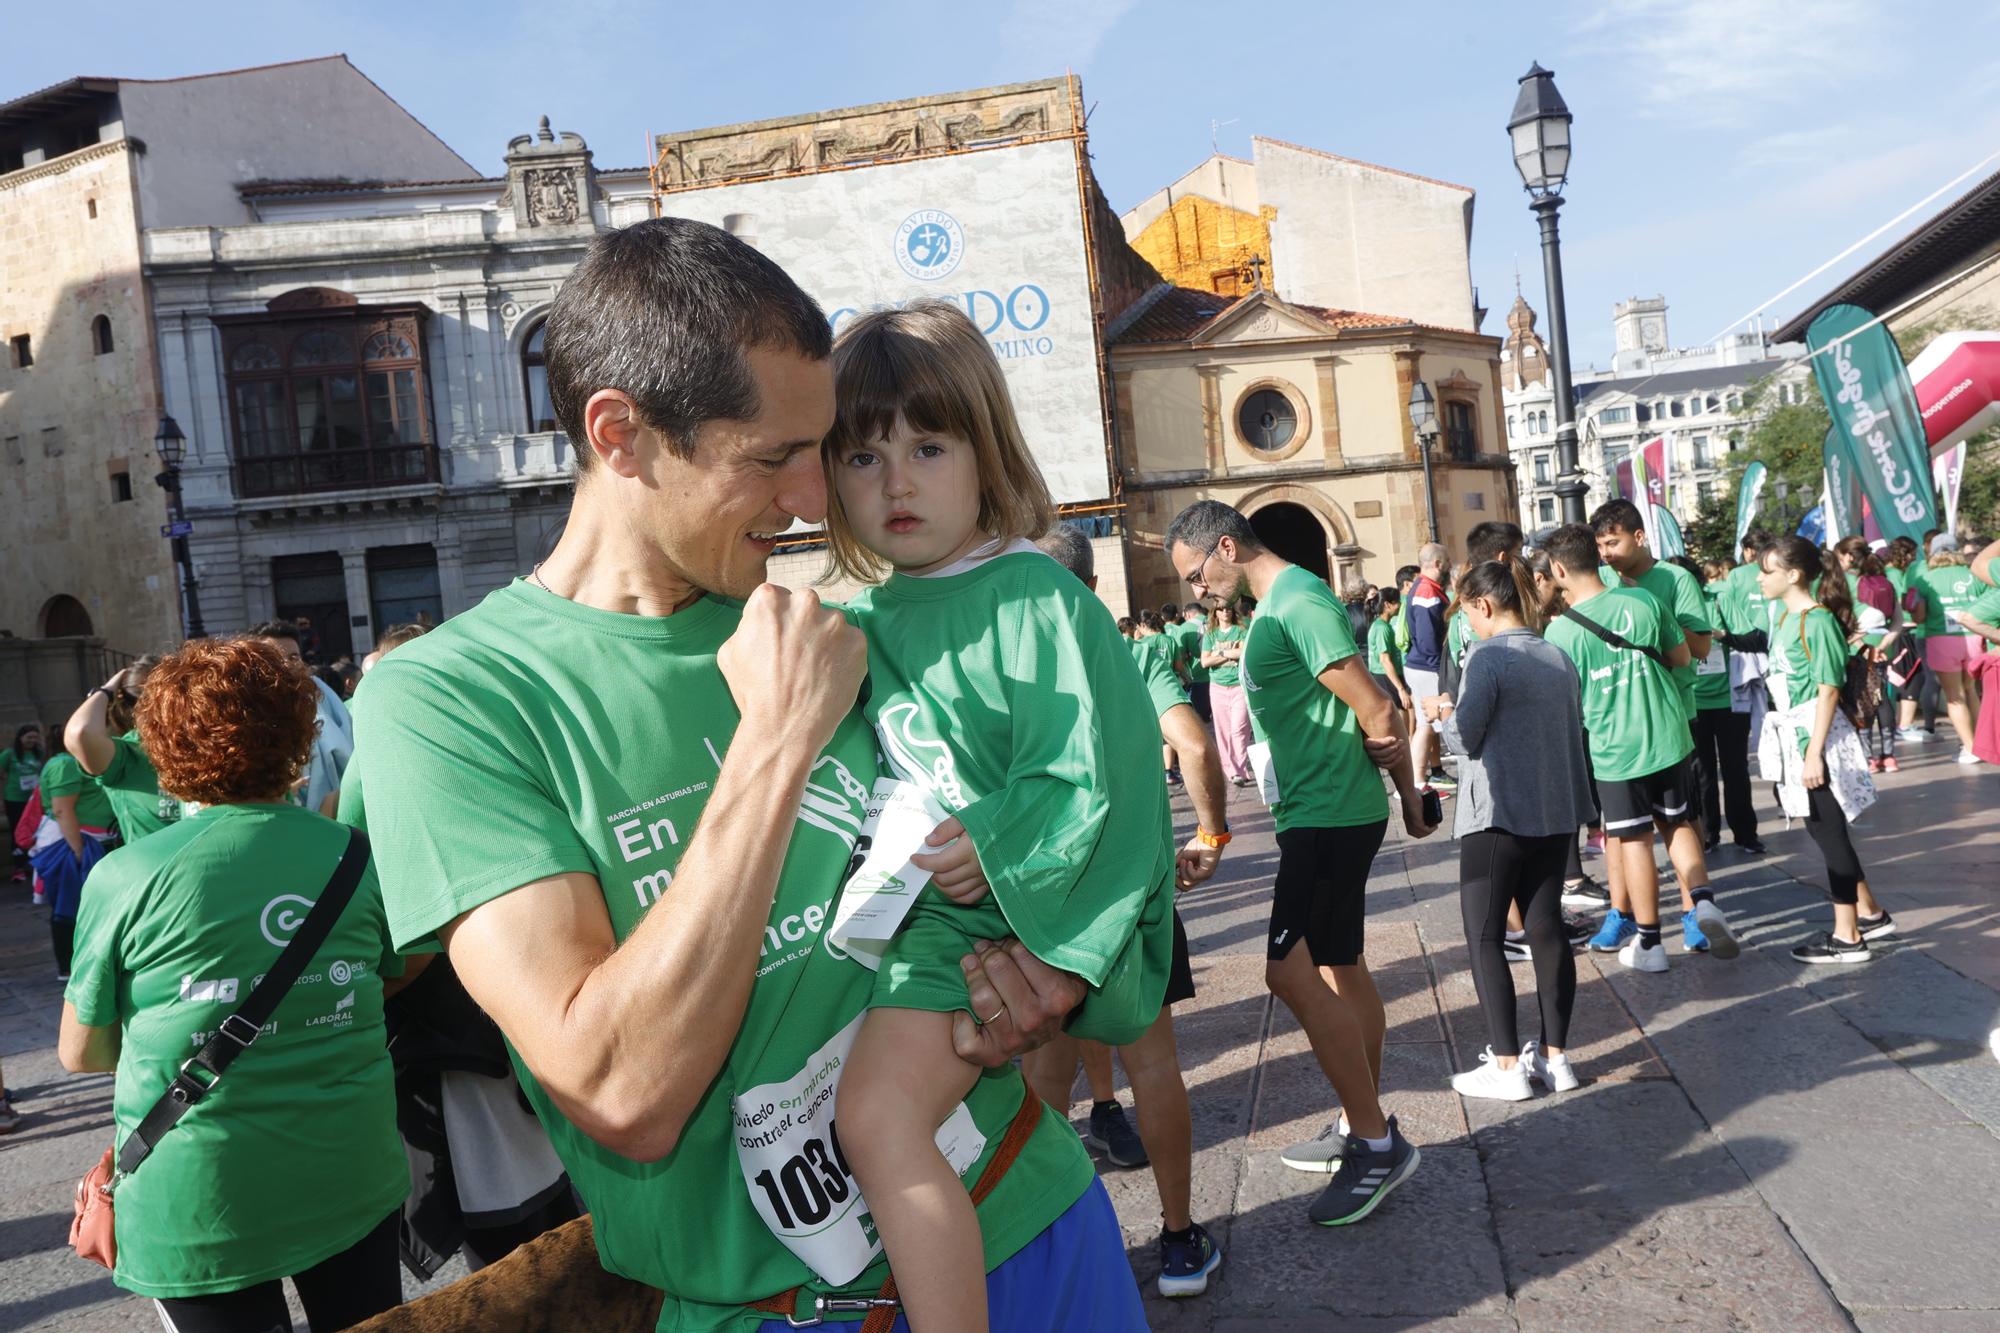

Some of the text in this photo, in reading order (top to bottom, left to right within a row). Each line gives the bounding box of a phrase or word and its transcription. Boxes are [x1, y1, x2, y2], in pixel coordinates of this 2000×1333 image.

[903, 212, 953, 234] OVIEDO
[992, 336, 1054, 361] MINO
[606, 781, 708, 823] MARCHA EN ASTURIAS 2022
[613, 818, 679, 863] En
[755, 958, 787, 977] CONTRA
[786, 952, 799, 962] EL
[305, 1012, 353, 1027] LABORAL
[734, 1056, 841, 1129] Oviedo en marcha
[739, 1083, 834, 1149] contra el cáncer
